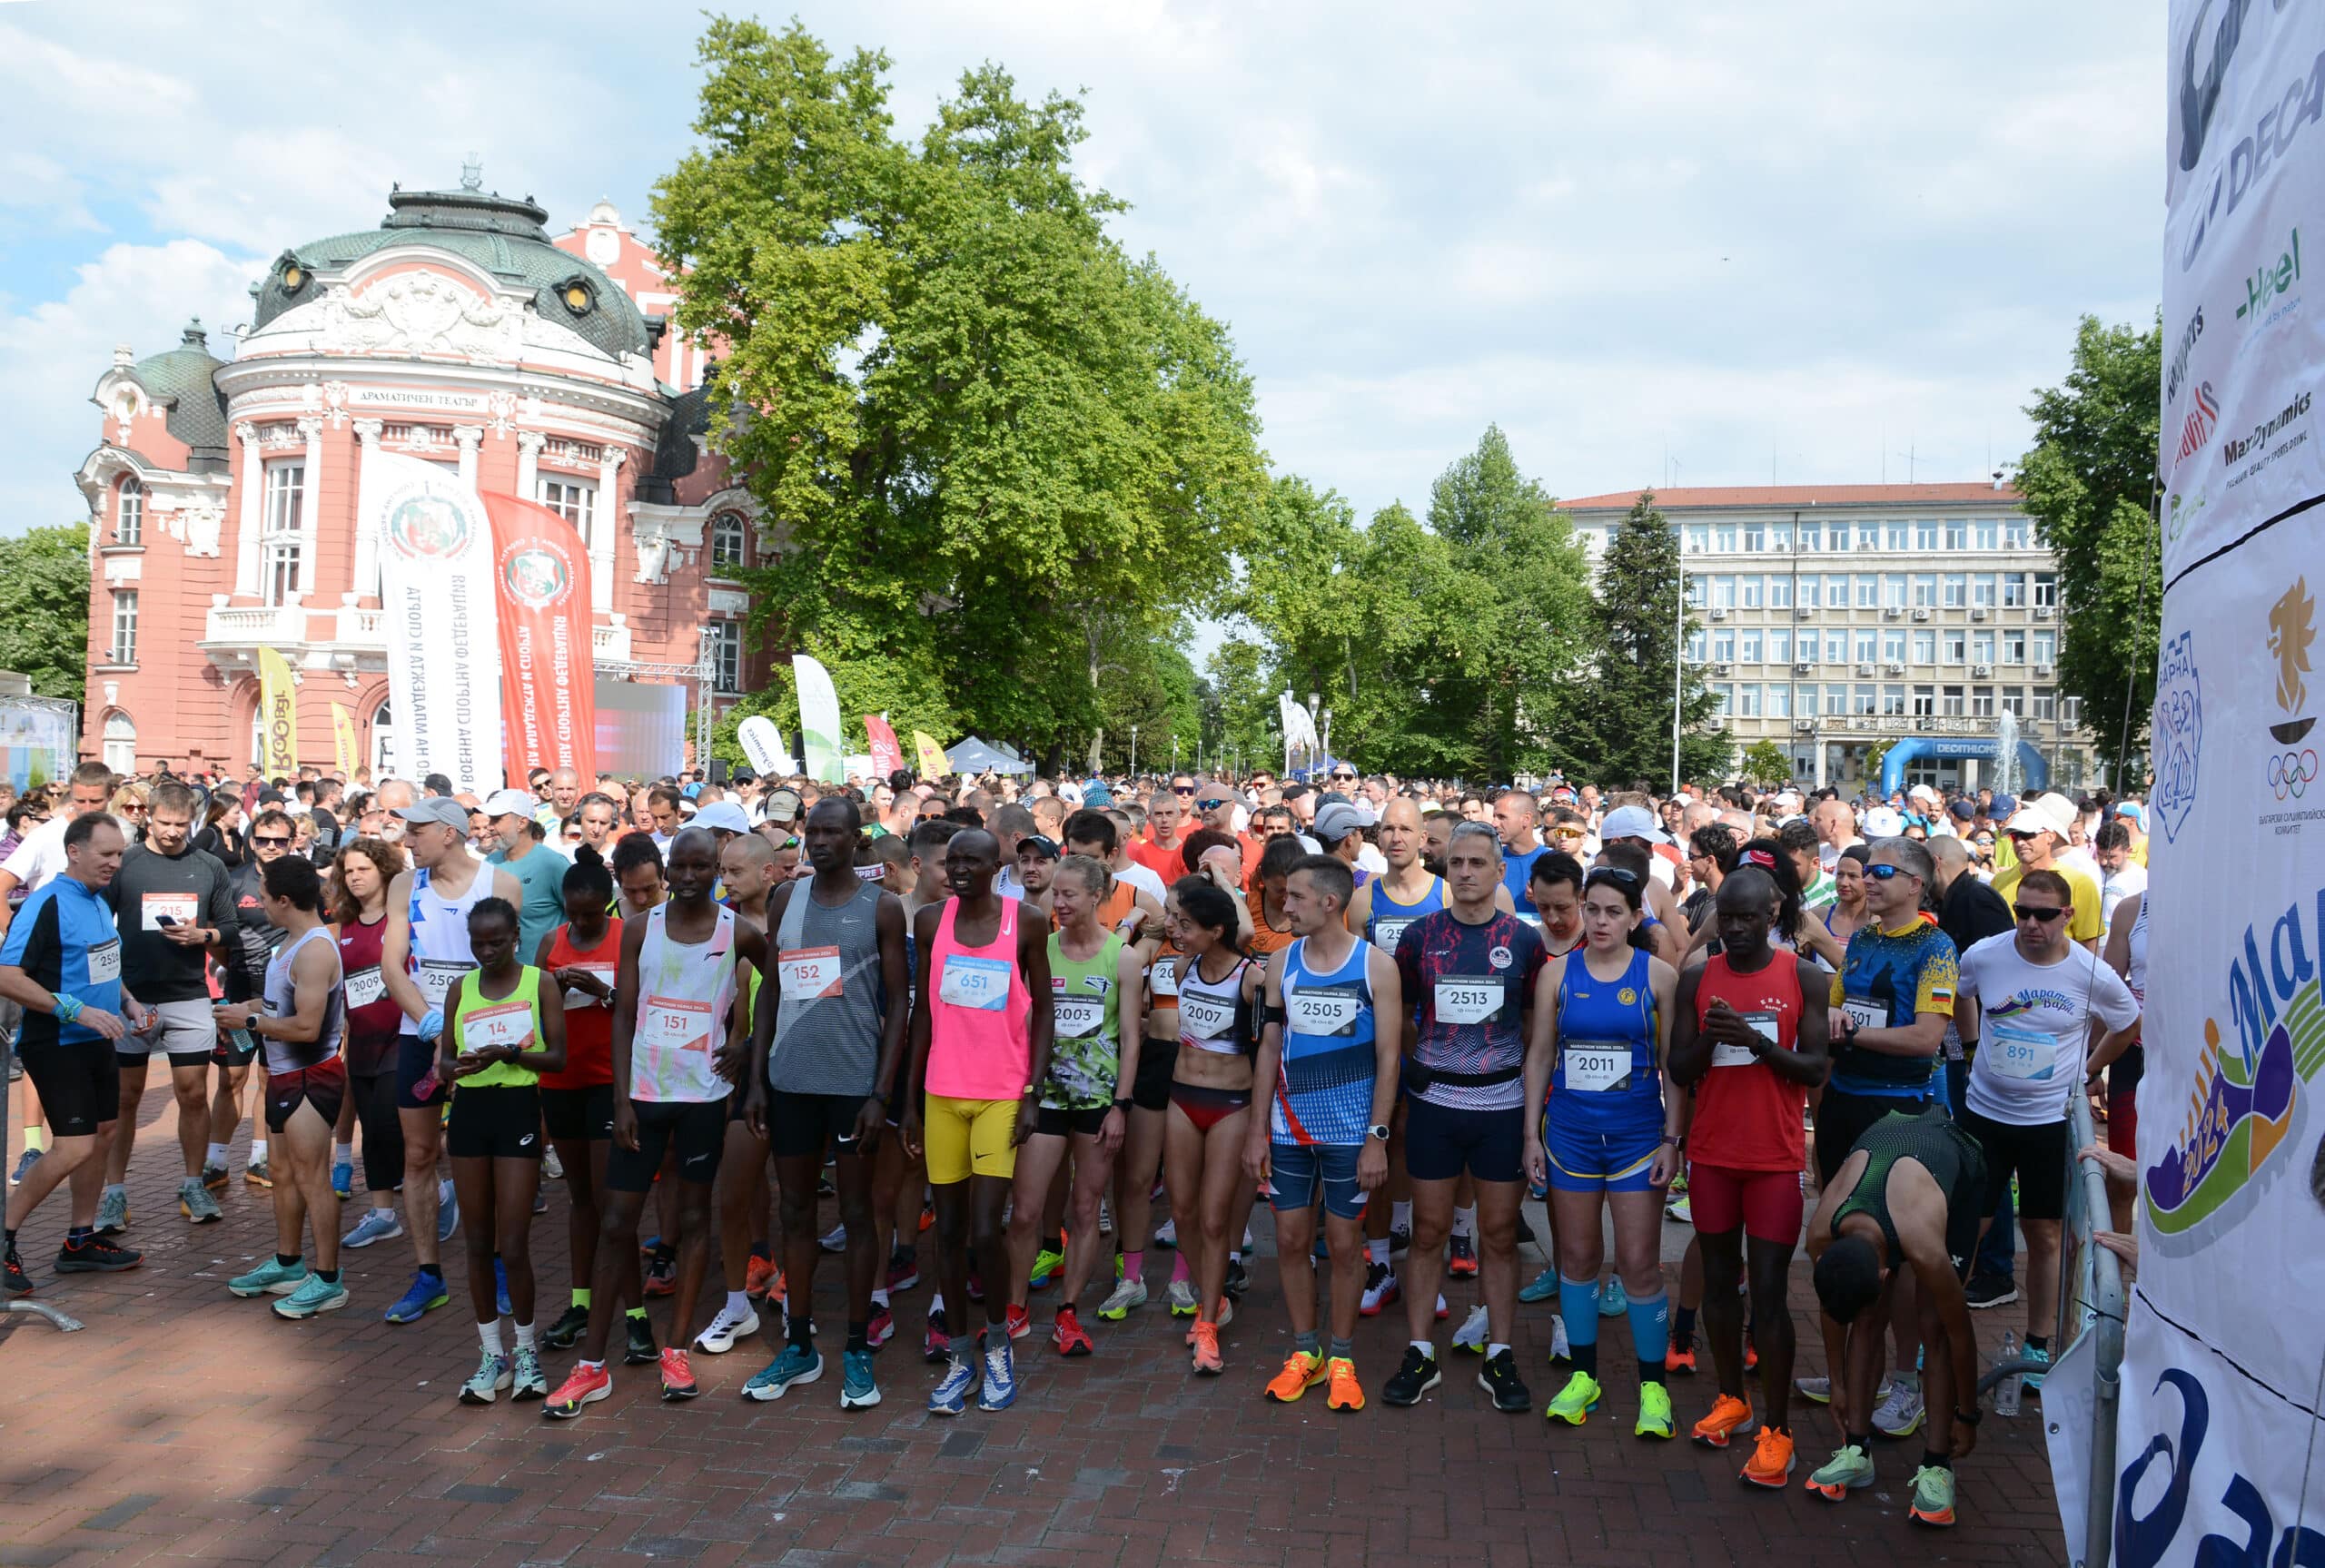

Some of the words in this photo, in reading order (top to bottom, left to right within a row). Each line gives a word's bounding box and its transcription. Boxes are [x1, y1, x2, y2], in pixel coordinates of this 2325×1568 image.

[2224, 391, 2311, 467] MaxDynamics
[2271, 441, 2289, 462] SPORTS
[1936, 743, 1994, 754] DECATHLON
[159, 905, 183, 916] 215
[794, 964, 820, 980] 152
[353, 976, 380, 992] 2009
[960, 973, 988, 990] 651
[1450, 991, 1488, 1005] 2513
[1054, 1008, 1092, 1021] 2003
[1187, 1005, 1222, 1023] 2007
[1302, 1002, 1342, 1017] 2505
[488, 1021, 508, 1035] 14
[663, 1015, 688, 1030] 151
[2007, 1045, 2034, 1060] 891
[1578, 1057, 1614, 1071] 2011
[2182, 1088, 2230, 1198] 2024
